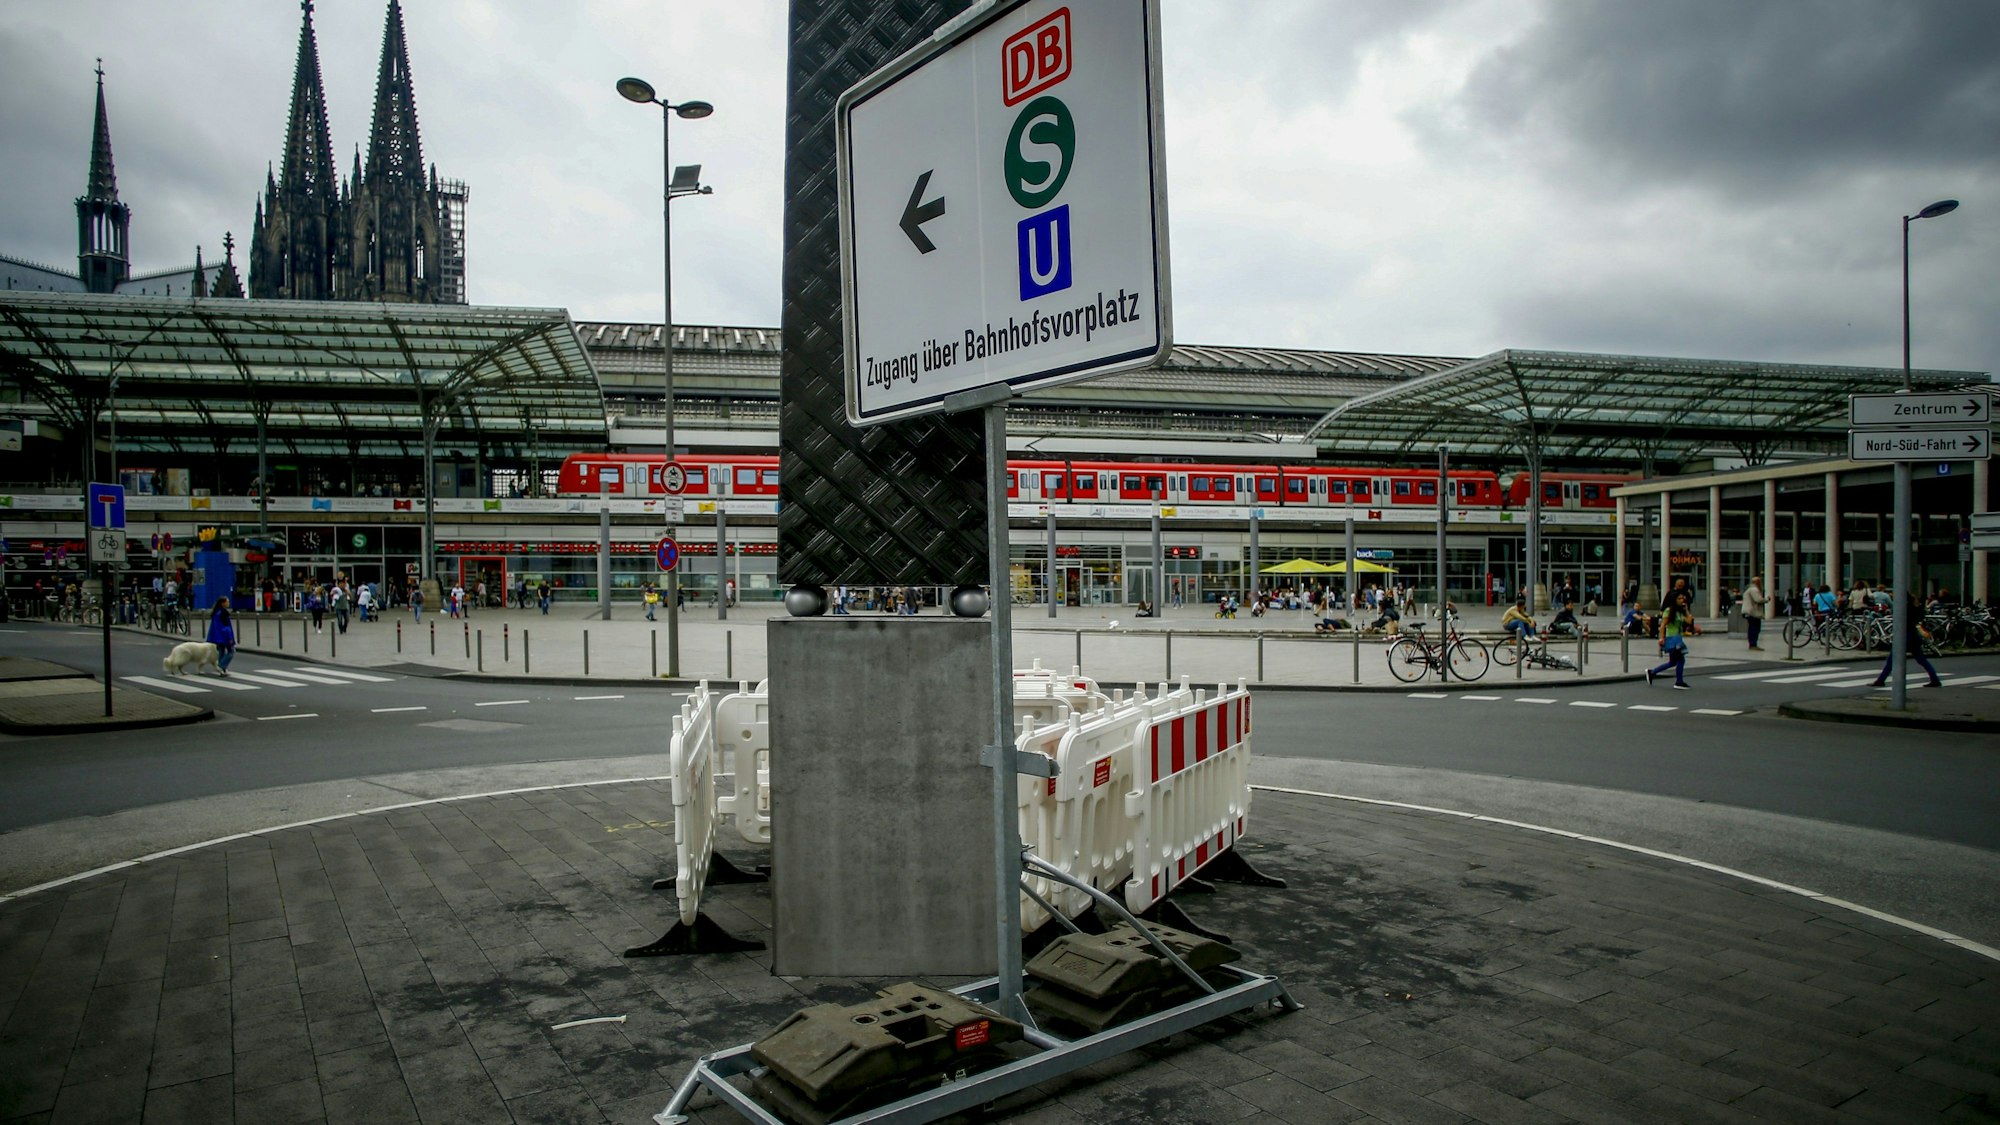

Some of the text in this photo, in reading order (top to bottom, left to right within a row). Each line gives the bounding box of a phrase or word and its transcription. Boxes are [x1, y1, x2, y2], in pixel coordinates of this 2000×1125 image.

[1010, 25, 1062, 93] DB
[1018, 113, 1063, 193] S
[1028, 219, 1059, 286] U
[866, 289, 1140, 390] Zugang über Bahnhofsvorplatz
[1893, 403, 1957, 416] Zentrum
[1866, 439, 1957, 452] Nord-Süd-Fahrt
[1938, 463, 1949, 474] U
[536, 543, 642, 553] INTERNATONAL
